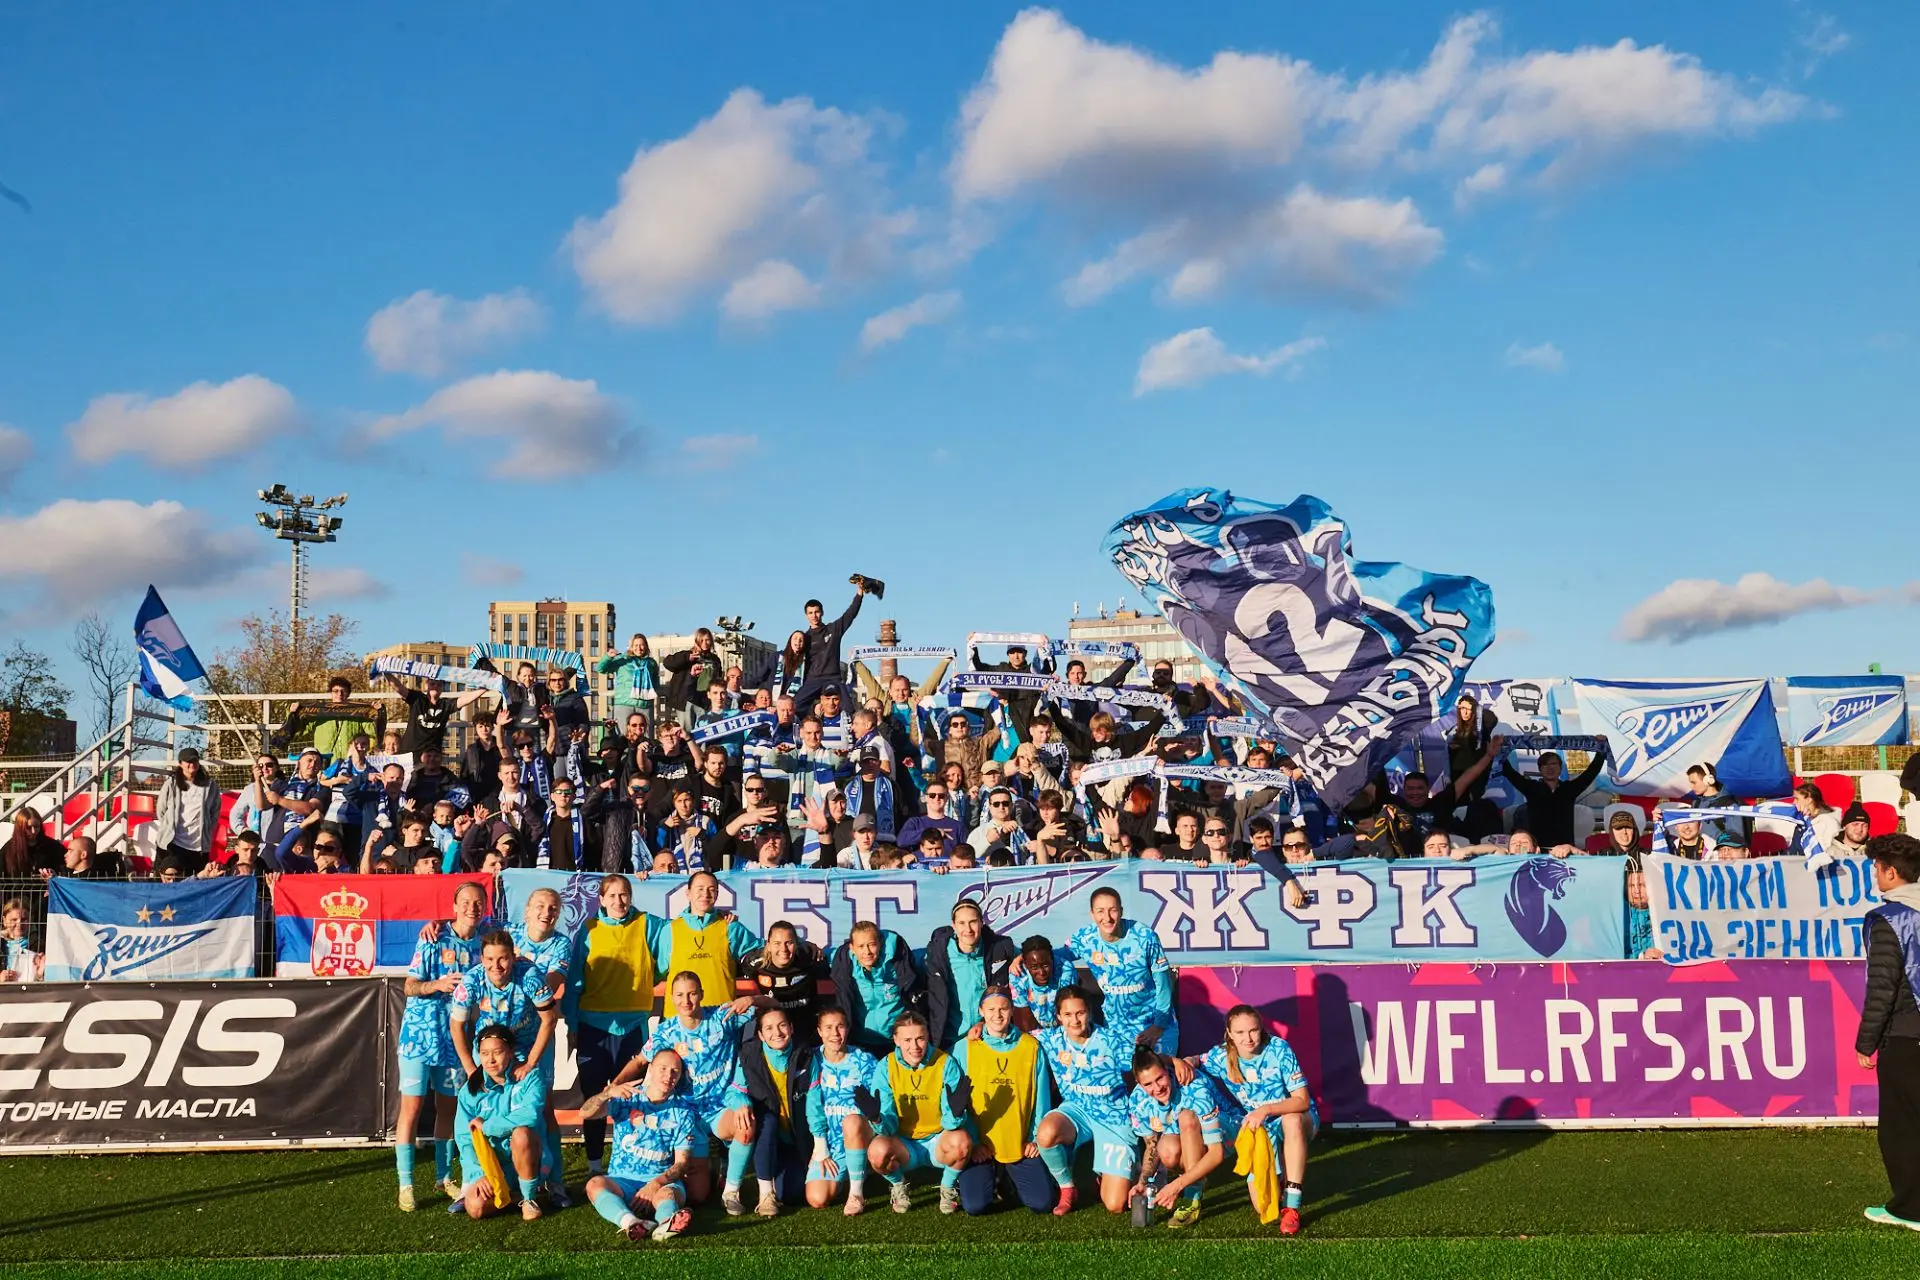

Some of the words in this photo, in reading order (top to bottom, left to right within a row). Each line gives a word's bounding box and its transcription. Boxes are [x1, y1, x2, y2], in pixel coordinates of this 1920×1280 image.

[411, 661, 440, 679] ИМЯ
[964, 675, 976, 685] ЗА
[978, 674, 1005, 686] РУСЬ!
[1005, 676, 1019, 686] ЗА
[1663, 860, 1787, 910] КИКИ
[1139, 866, 1478, 950] ЖФК
[1660, 919, 1714, 963] ЗА
[1348, 996, 1807, 1085] WFL.RFS.RU
[135, 1097, 257, 1119] МАСЛА
[1103, 1142, 1127, 1169] 77
